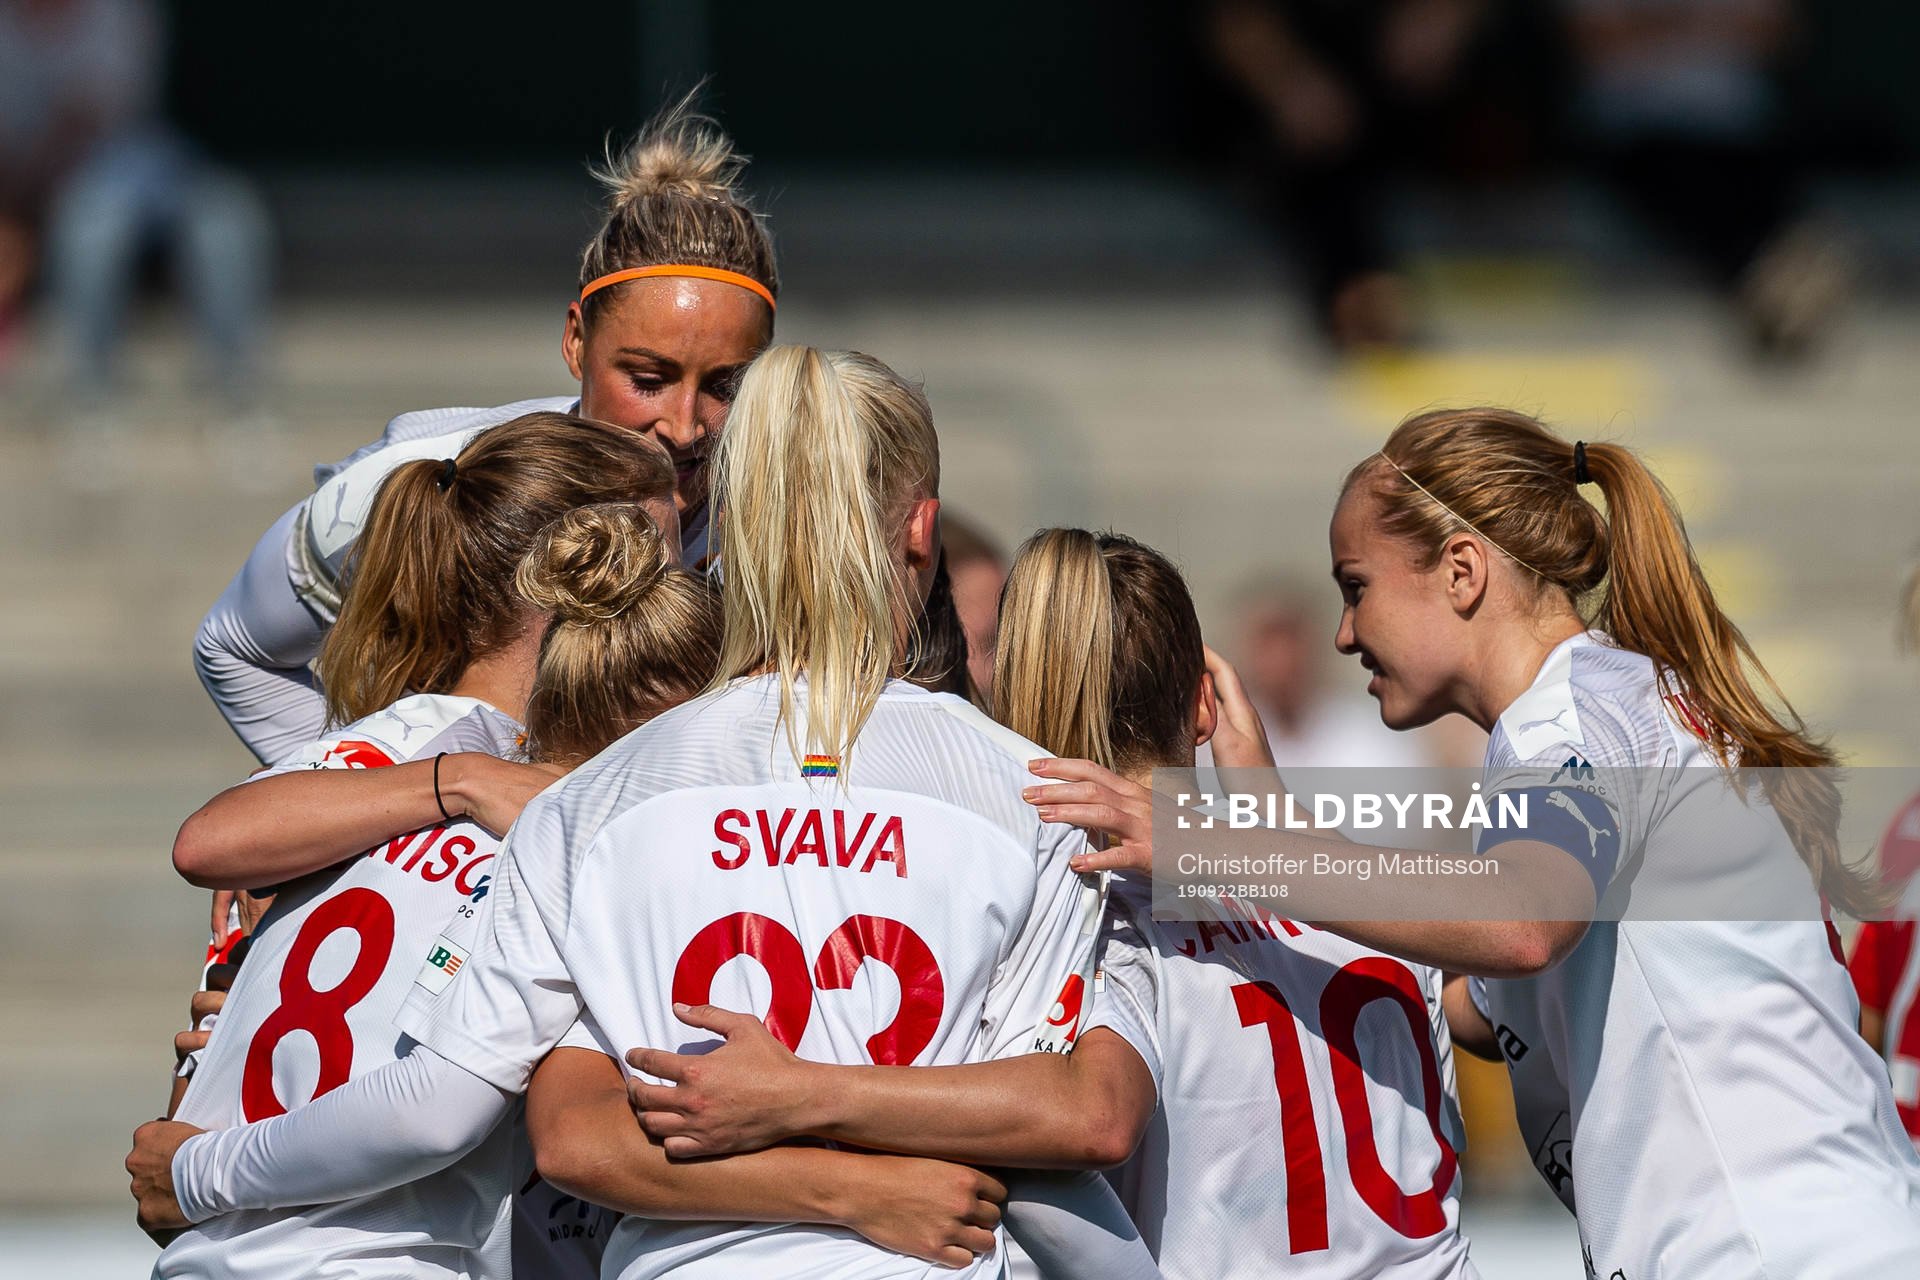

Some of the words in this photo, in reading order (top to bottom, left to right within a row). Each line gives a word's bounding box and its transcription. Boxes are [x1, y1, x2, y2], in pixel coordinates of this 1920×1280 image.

[711, 807, 908, 879] SVAVA
[241, 887, 396, 1124] 8
[1230, 956, 1457, 1255] 10
